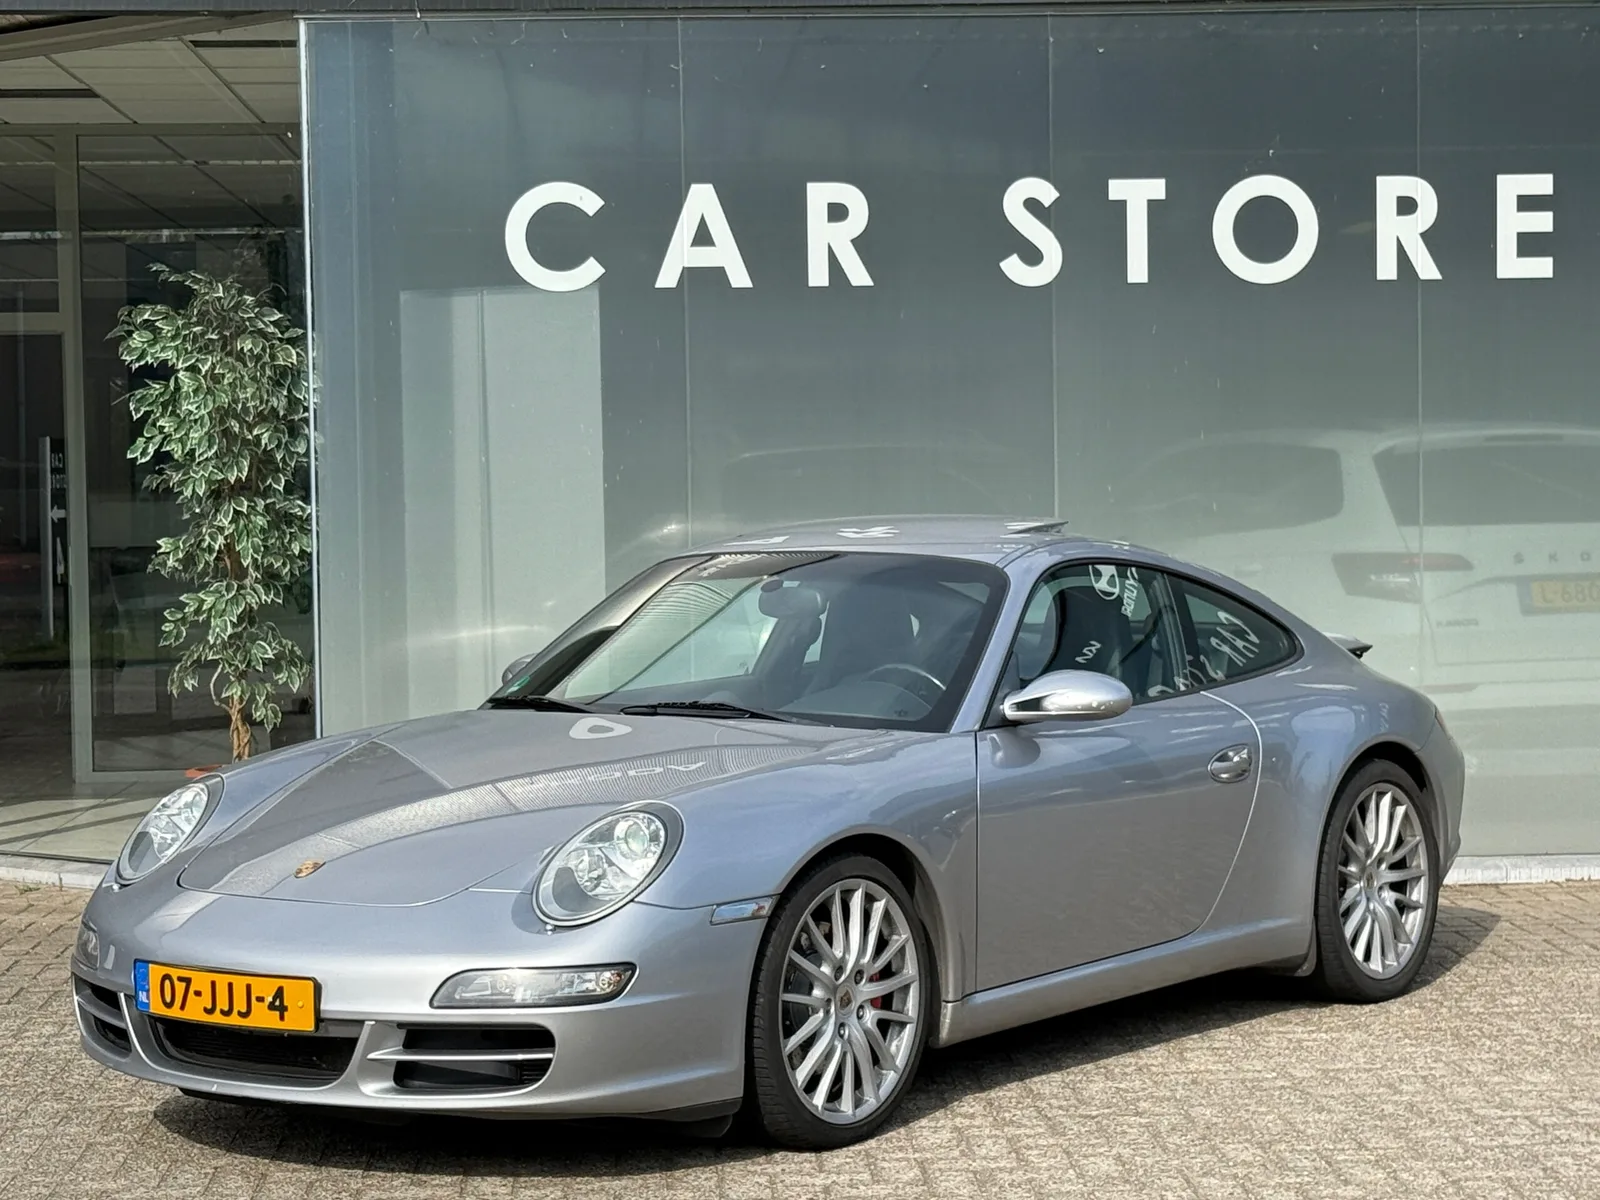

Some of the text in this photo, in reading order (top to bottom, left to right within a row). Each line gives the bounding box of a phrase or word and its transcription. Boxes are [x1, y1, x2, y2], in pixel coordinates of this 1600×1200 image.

[505, 174, 1555, 291] CAR STORE
[159, 973, 289, 1022] 07-JJJ-4
